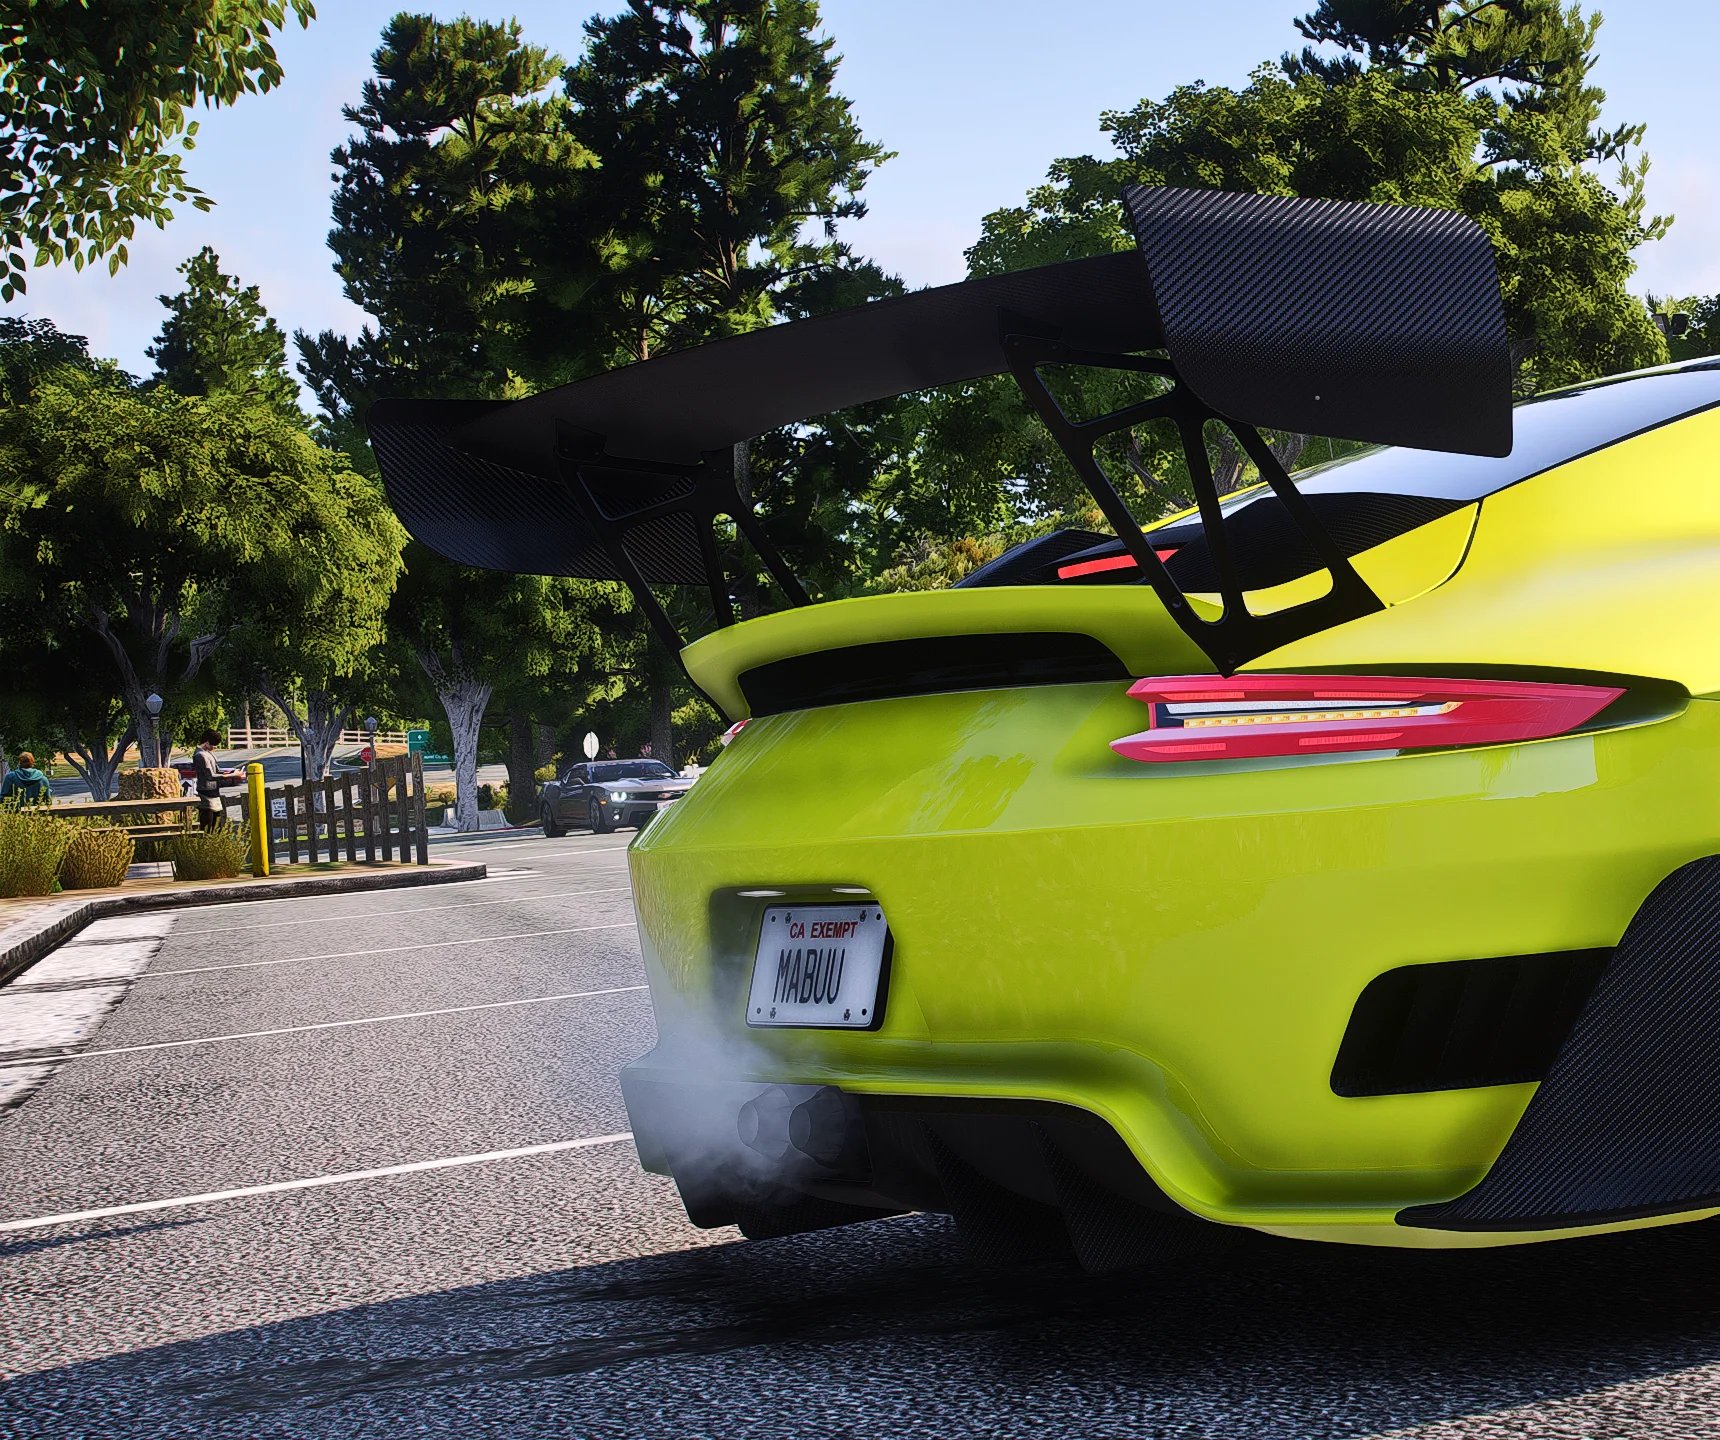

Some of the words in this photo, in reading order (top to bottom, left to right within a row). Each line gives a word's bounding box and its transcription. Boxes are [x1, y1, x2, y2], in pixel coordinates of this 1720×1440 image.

[273, 809, 288, 818] 25
[789, 921, 806, 939] CA
[810, 921, 859, 939] EXEMPT
[772, 947, 846, 1005] MABUU
